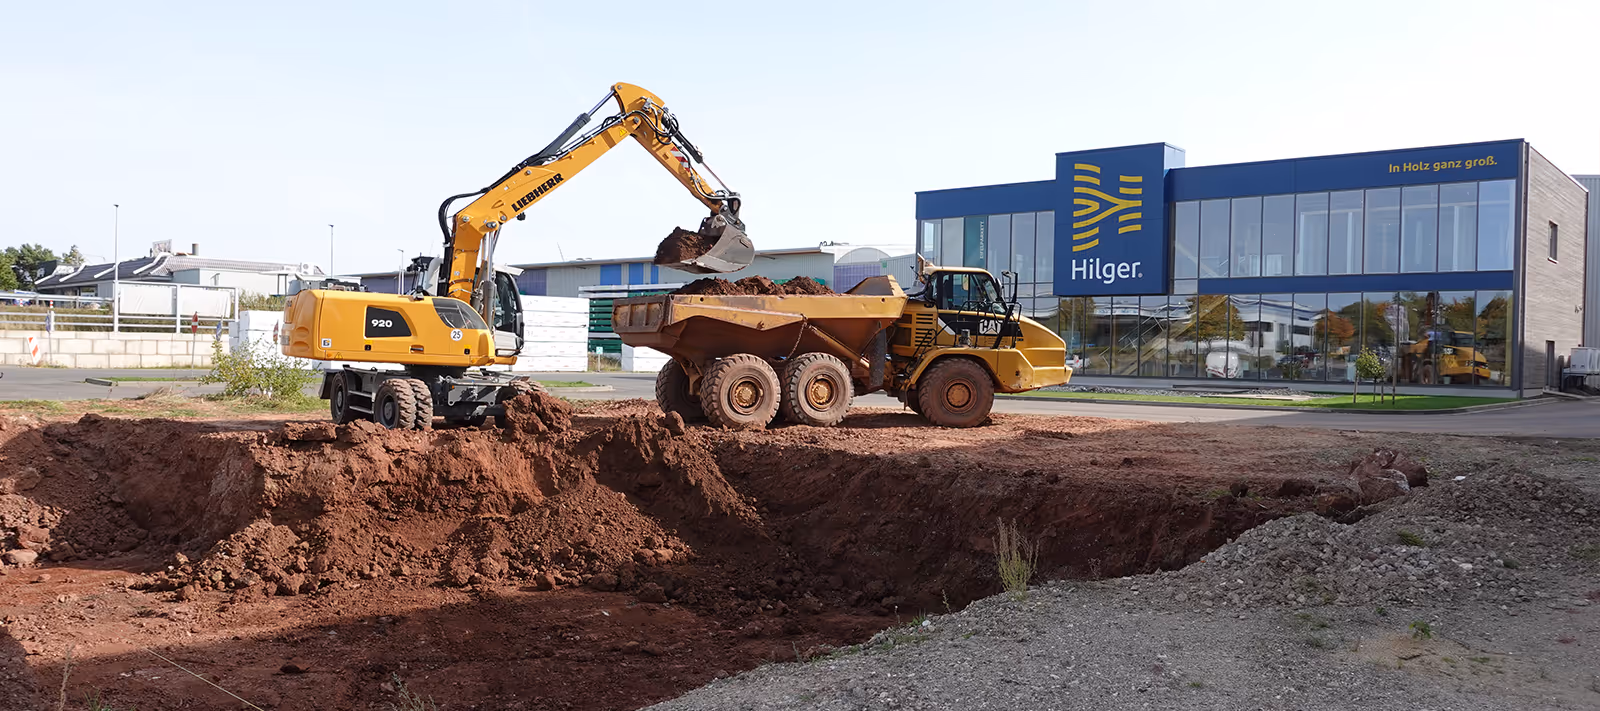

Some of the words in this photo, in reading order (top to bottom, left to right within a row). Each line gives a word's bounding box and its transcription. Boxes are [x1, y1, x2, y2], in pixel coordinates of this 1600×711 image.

[1388, 164, 1400, 173] In
[1403, 161, 1430, 172] Holz
[1433, 160, 1462, 171] ganz
[1465, 156, 1498, 169] groß.
[511, 173, 564, 212] LIEBHERR
[371, 319, 393, 328] 920
[979, 319, 1003, 335] CAT
[452, 331, 461, 339] 25
